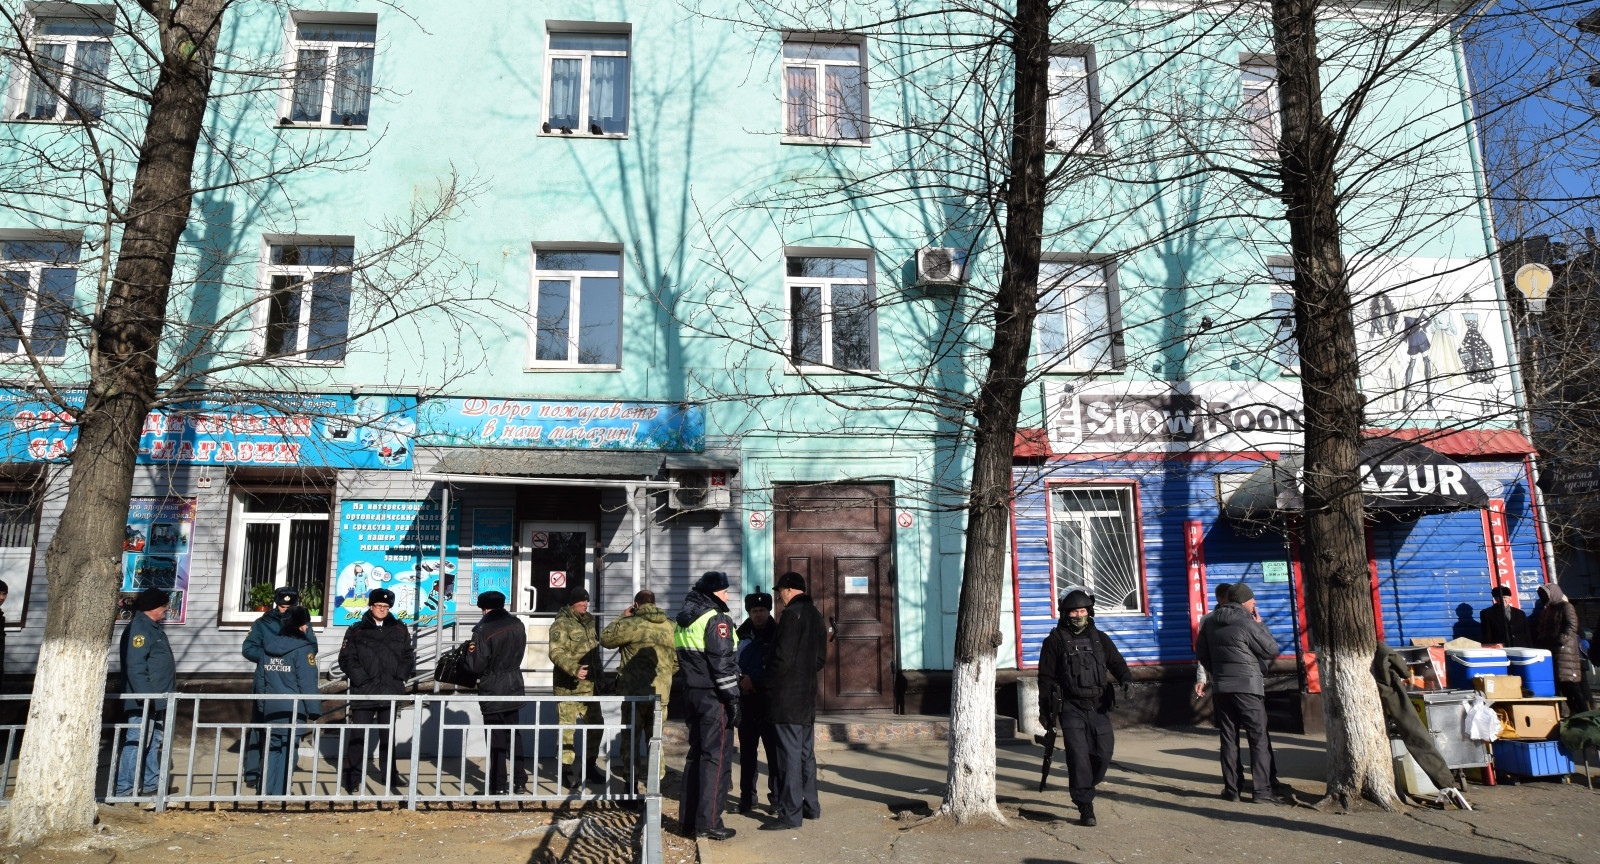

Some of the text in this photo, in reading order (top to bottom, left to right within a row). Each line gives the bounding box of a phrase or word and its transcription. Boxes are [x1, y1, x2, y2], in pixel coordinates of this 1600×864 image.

[461, 398, 658, 425] Добро пожаловать
[482, 419, 638, 447] в наш магазин!
[346, 513, 416, 521] ортопедические
[353, 524, 391, 532] средства
